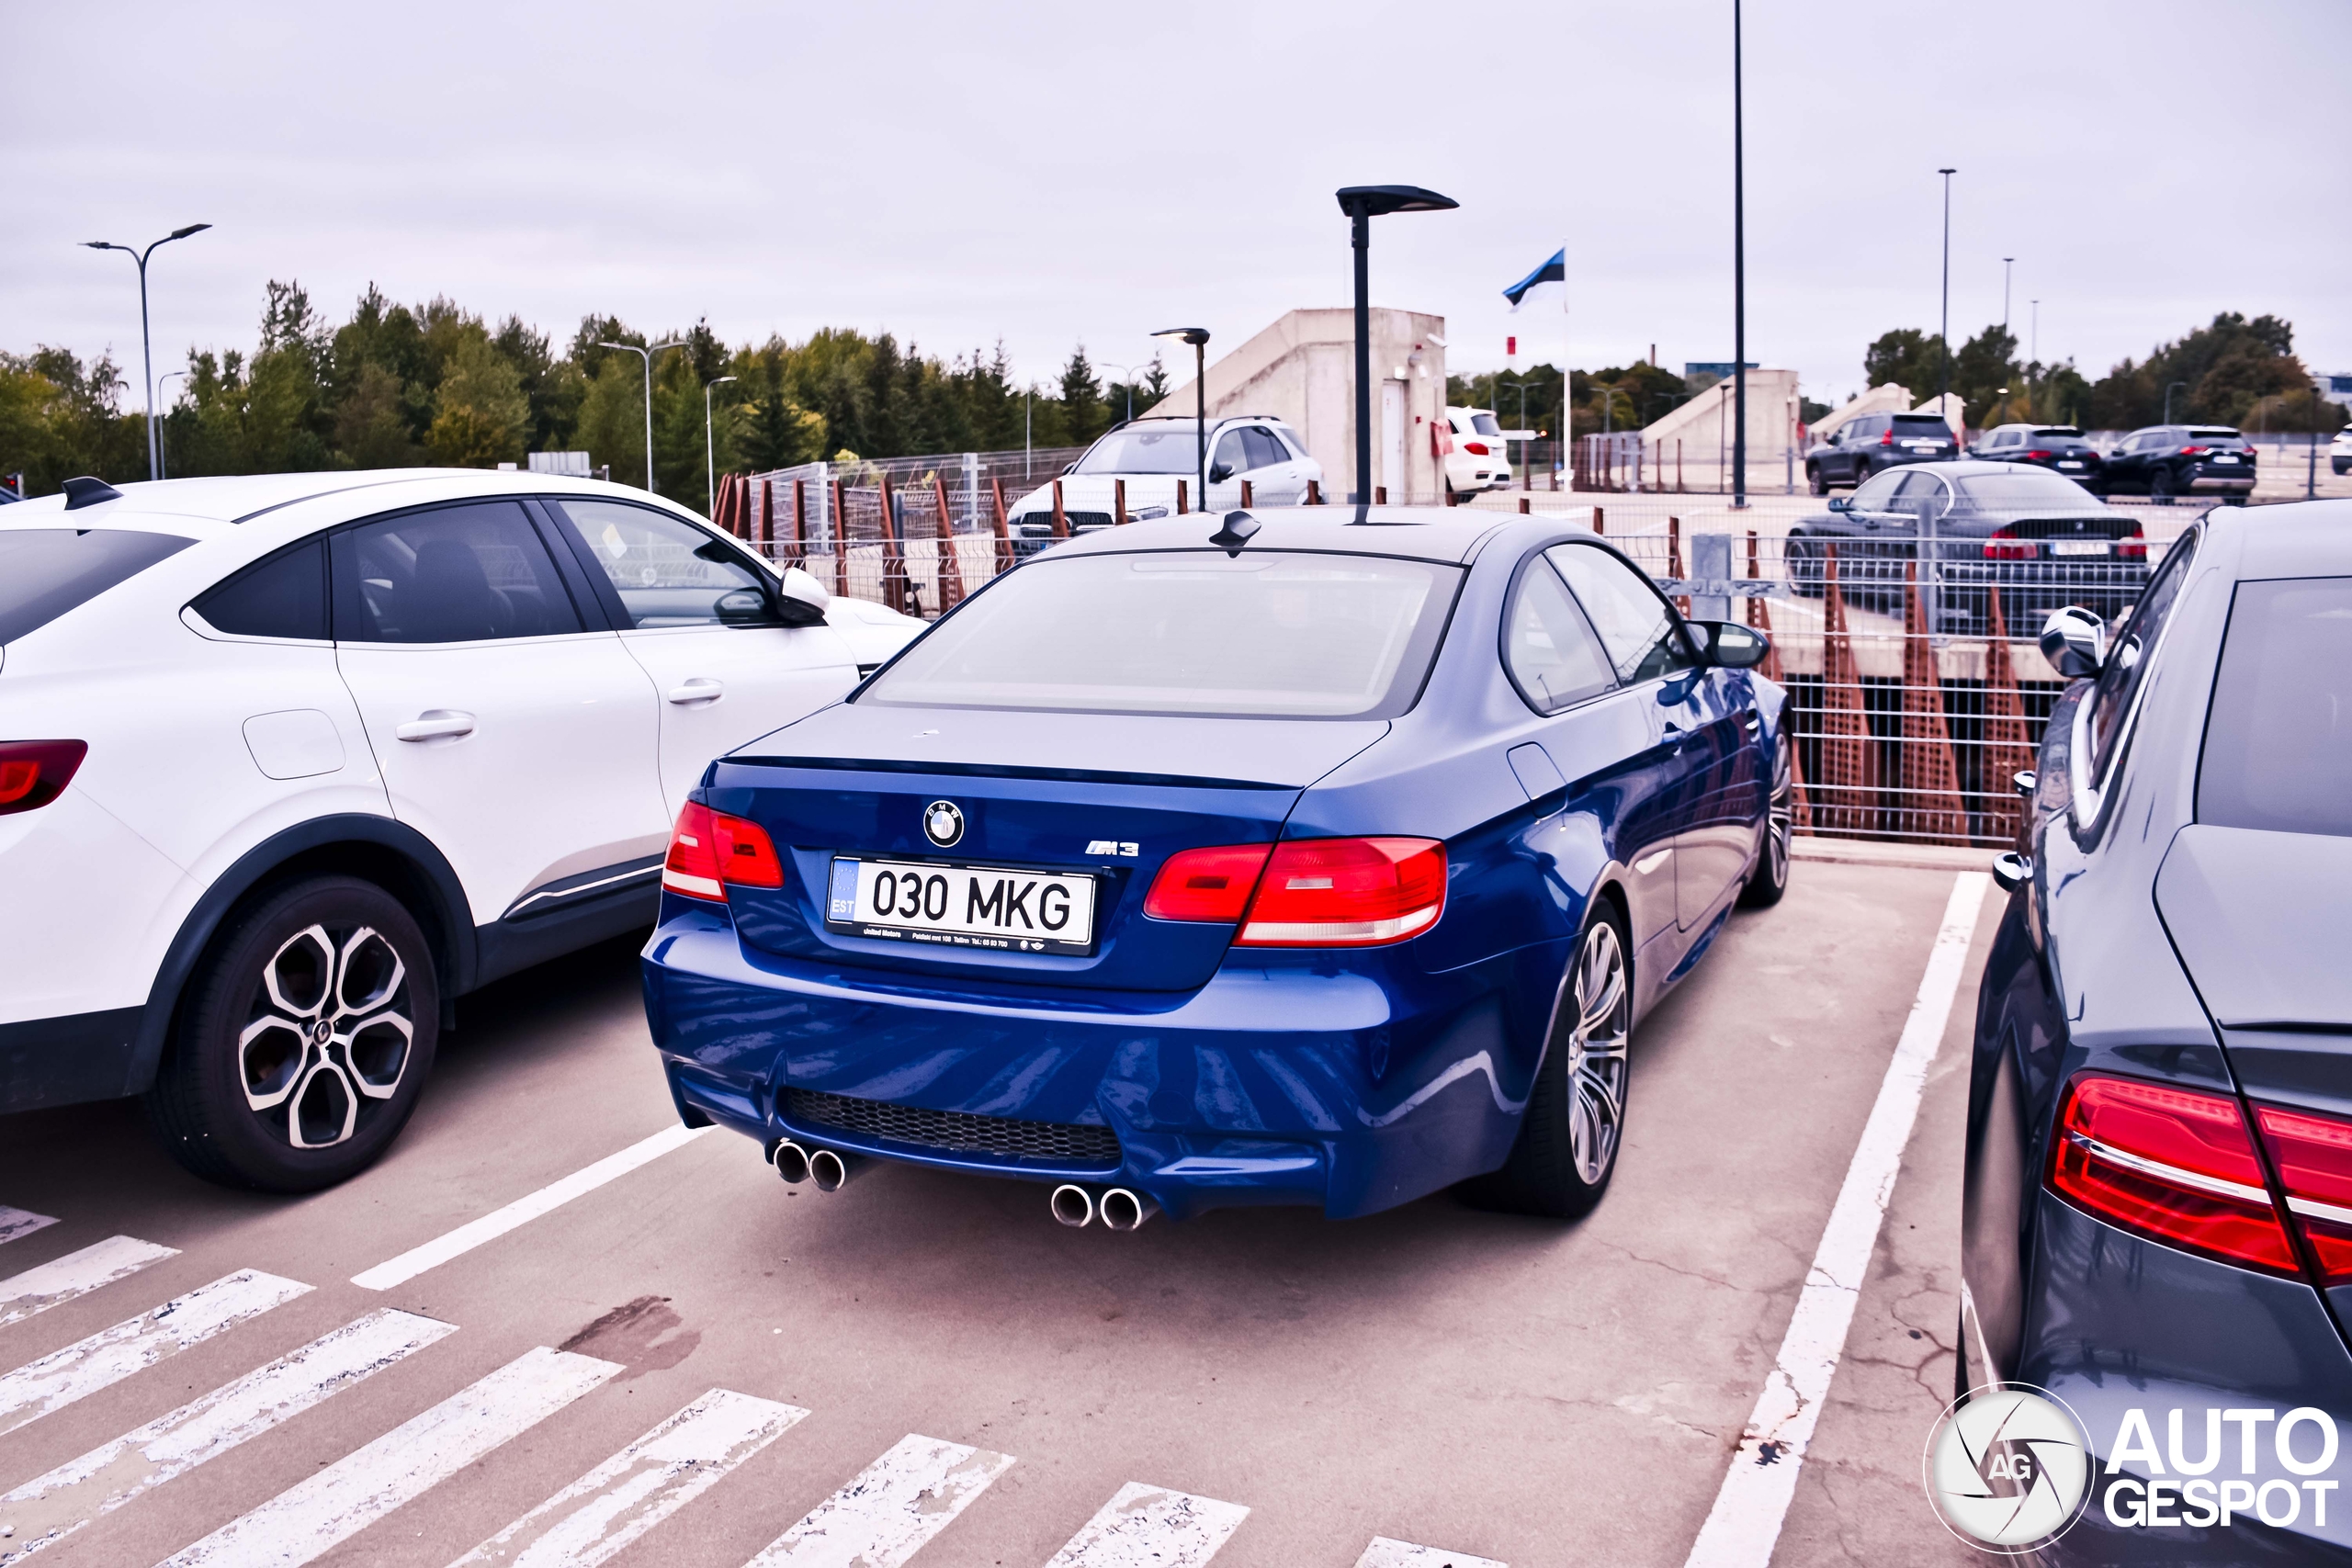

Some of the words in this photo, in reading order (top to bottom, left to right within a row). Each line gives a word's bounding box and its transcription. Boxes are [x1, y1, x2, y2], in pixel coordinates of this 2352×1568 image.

[927, 803, 960, 819] BMW
[1085, 840, 1139, 857] M3
[831, 898, 854, 914] EST
[873, 870, 948, 921] 030
[967, 876, 1070, 931] MKG
[863, 928, 882, 936] United
[882, 930, 901, 938] Motors
[953, 936, 969, 944] Tallinn
